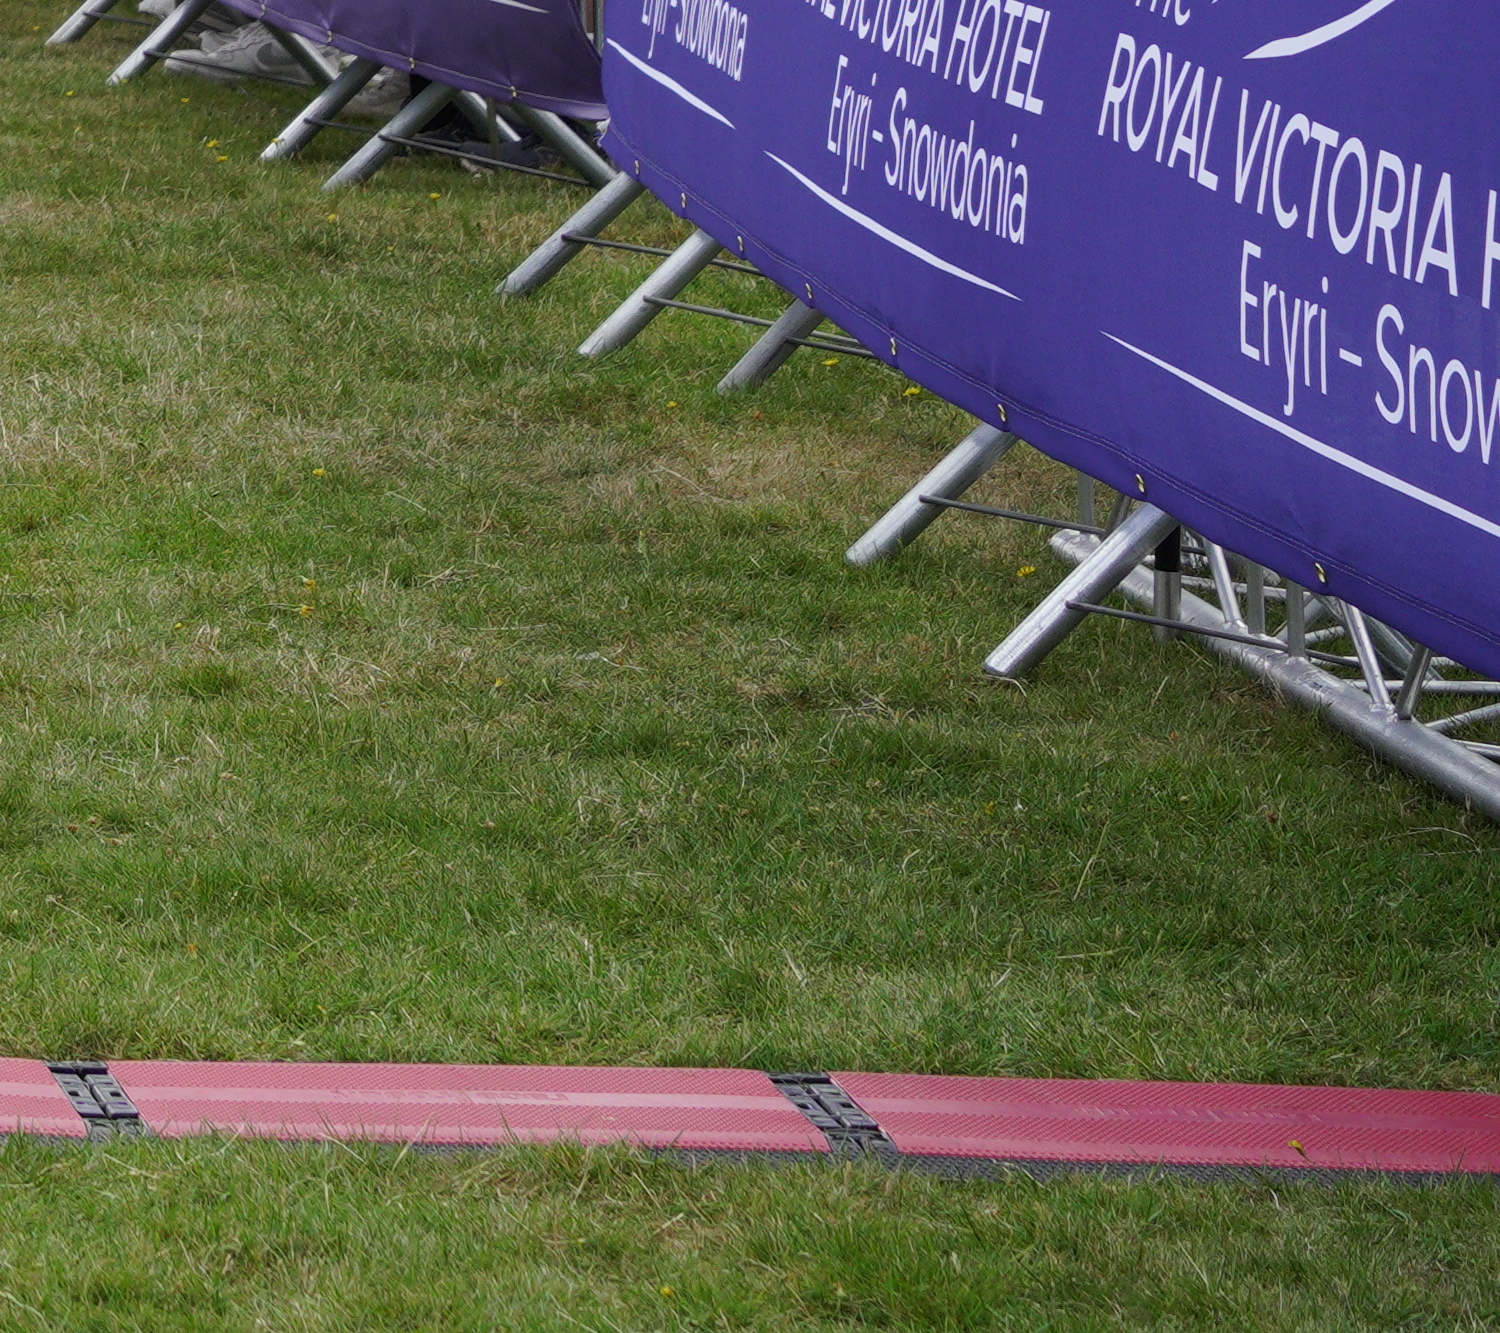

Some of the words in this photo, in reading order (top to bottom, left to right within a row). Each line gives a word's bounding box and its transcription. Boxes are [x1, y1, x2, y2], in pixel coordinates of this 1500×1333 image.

[826, 54, 881, 195] Eryri
[883, 84, 1029, 248] Snowdonia
[1098, 32, 1222, 193] ROYAL
[1233, 84, 1460, 300] VICTORIA
[1239, 239, 1331, 416] Eryri
